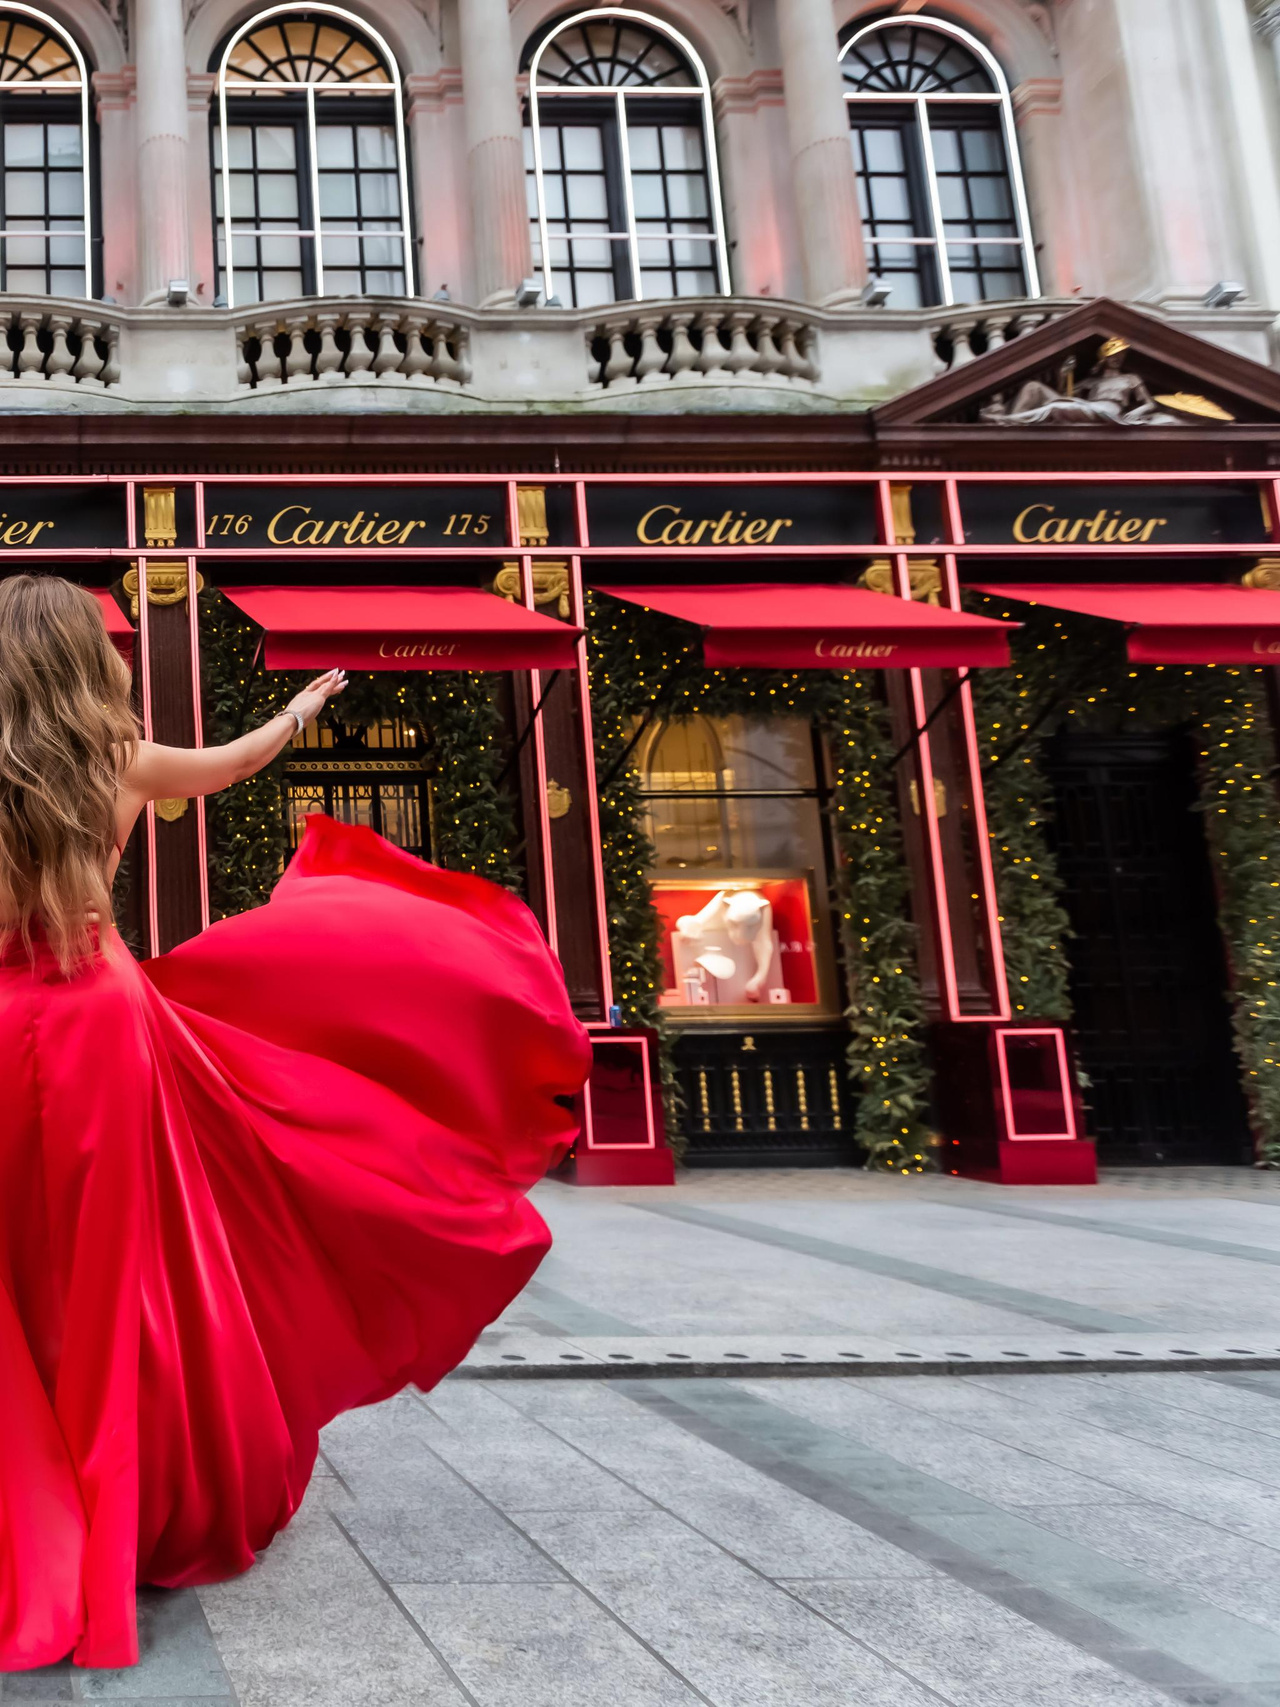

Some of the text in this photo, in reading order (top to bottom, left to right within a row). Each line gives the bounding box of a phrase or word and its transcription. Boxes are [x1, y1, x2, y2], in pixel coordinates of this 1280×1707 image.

[205, 505, 490, 545] 176 Cartier 175
[636, 504, 793, 545] Cartier
[1012, 503, 1168, 543] Cartier
[379, 640, 461, 658] Cartier
[815, 639, 898, 658] Cartier
